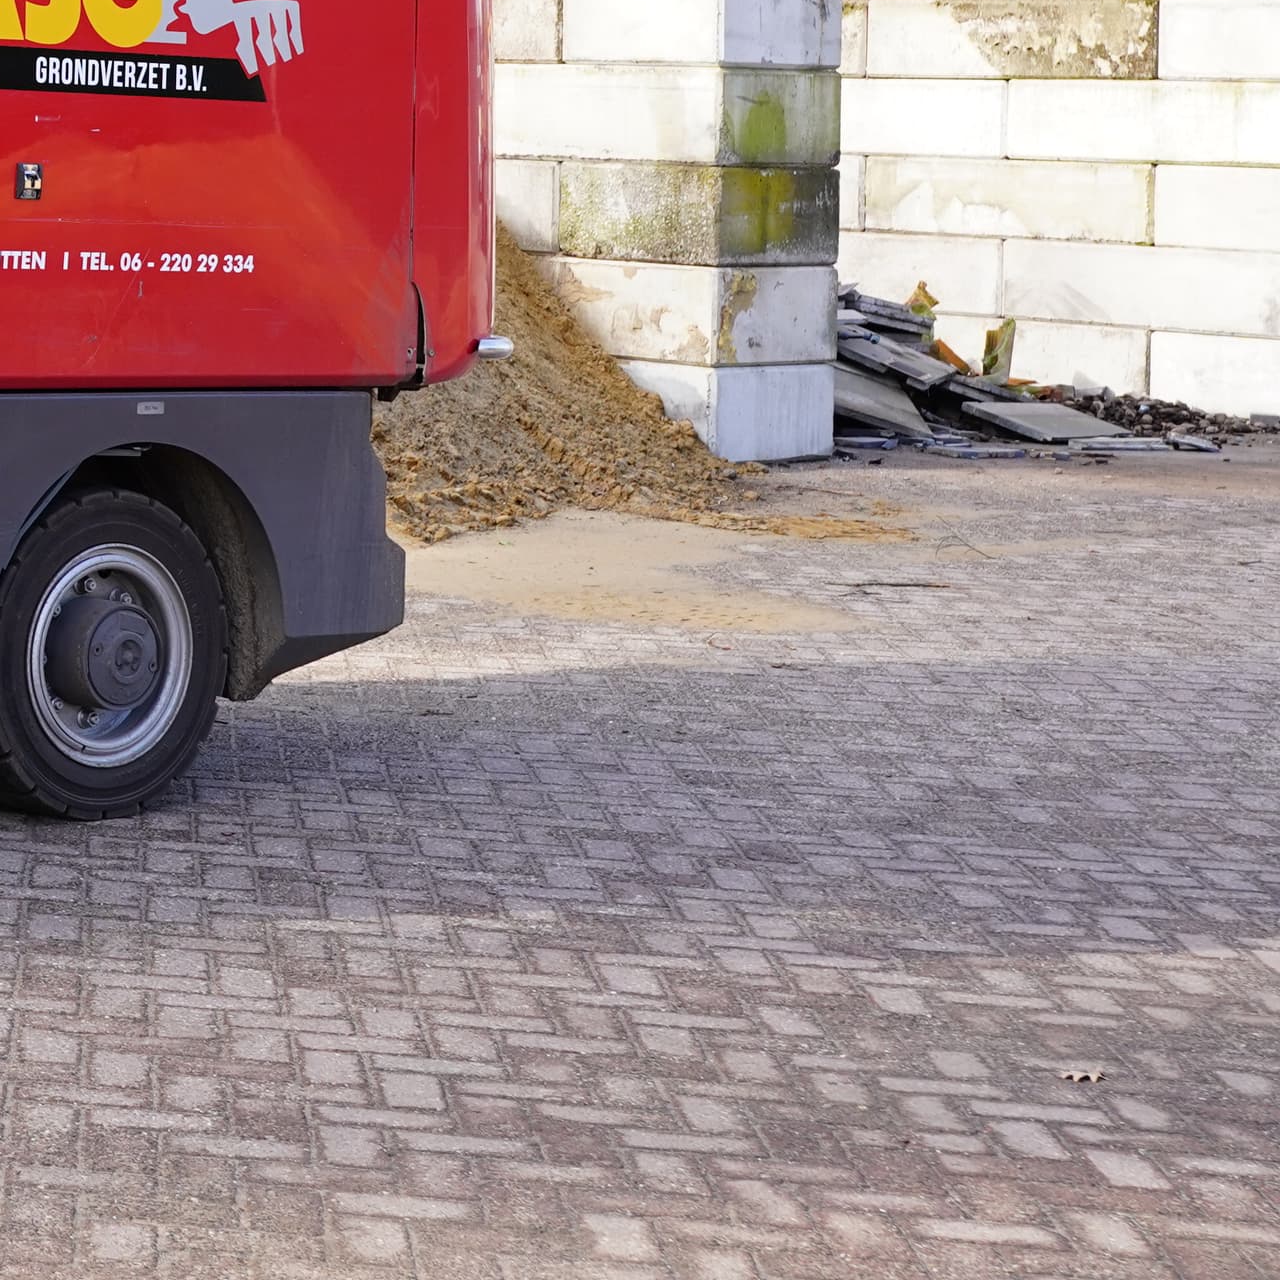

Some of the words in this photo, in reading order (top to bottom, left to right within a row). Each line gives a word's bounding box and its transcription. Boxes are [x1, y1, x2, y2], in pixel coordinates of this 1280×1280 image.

[35, 56, 170, 90] GRONDVERZET
[175, 64, 207, 92] B.V.
[80, 252, 114, 271] TEL.
[120, 253, 141, 271] 06
[160, 253, 191, 272] 220
[197, 254, 218, 272] 29
[222, 254, 254, 273] 334
